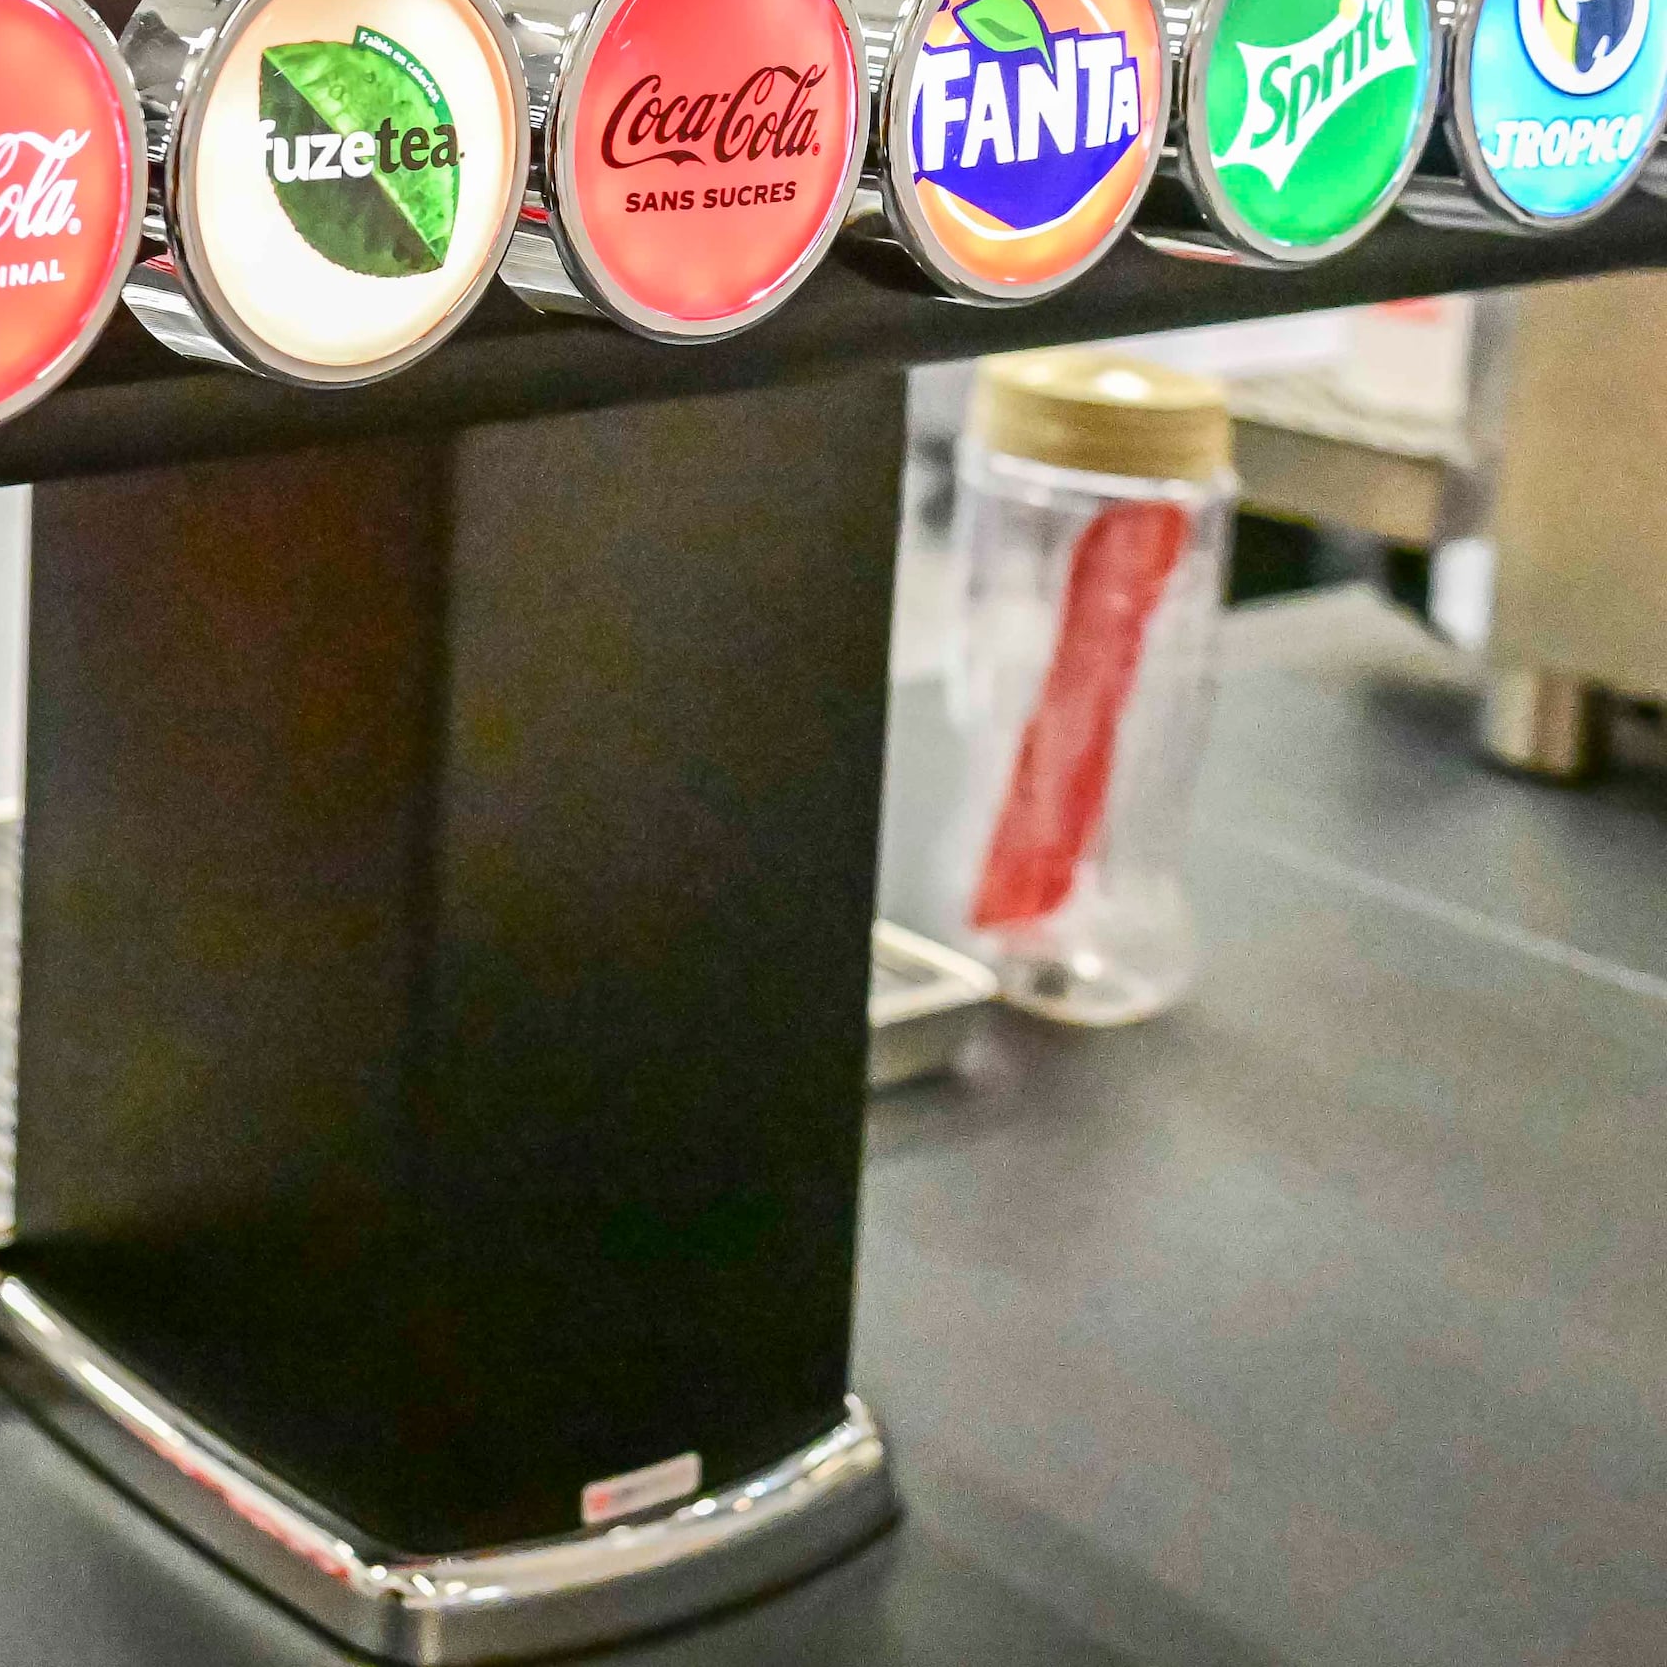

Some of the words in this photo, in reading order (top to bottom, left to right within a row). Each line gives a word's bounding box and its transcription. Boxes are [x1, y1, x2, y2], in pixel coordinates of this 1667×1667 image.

[601, 63, 829, 170] Coca-Cola
[921, 37, 1140, 172] FANTA
[624, 189, 695, 213] SANS
[702, 180, 797, 209] SUCRES
